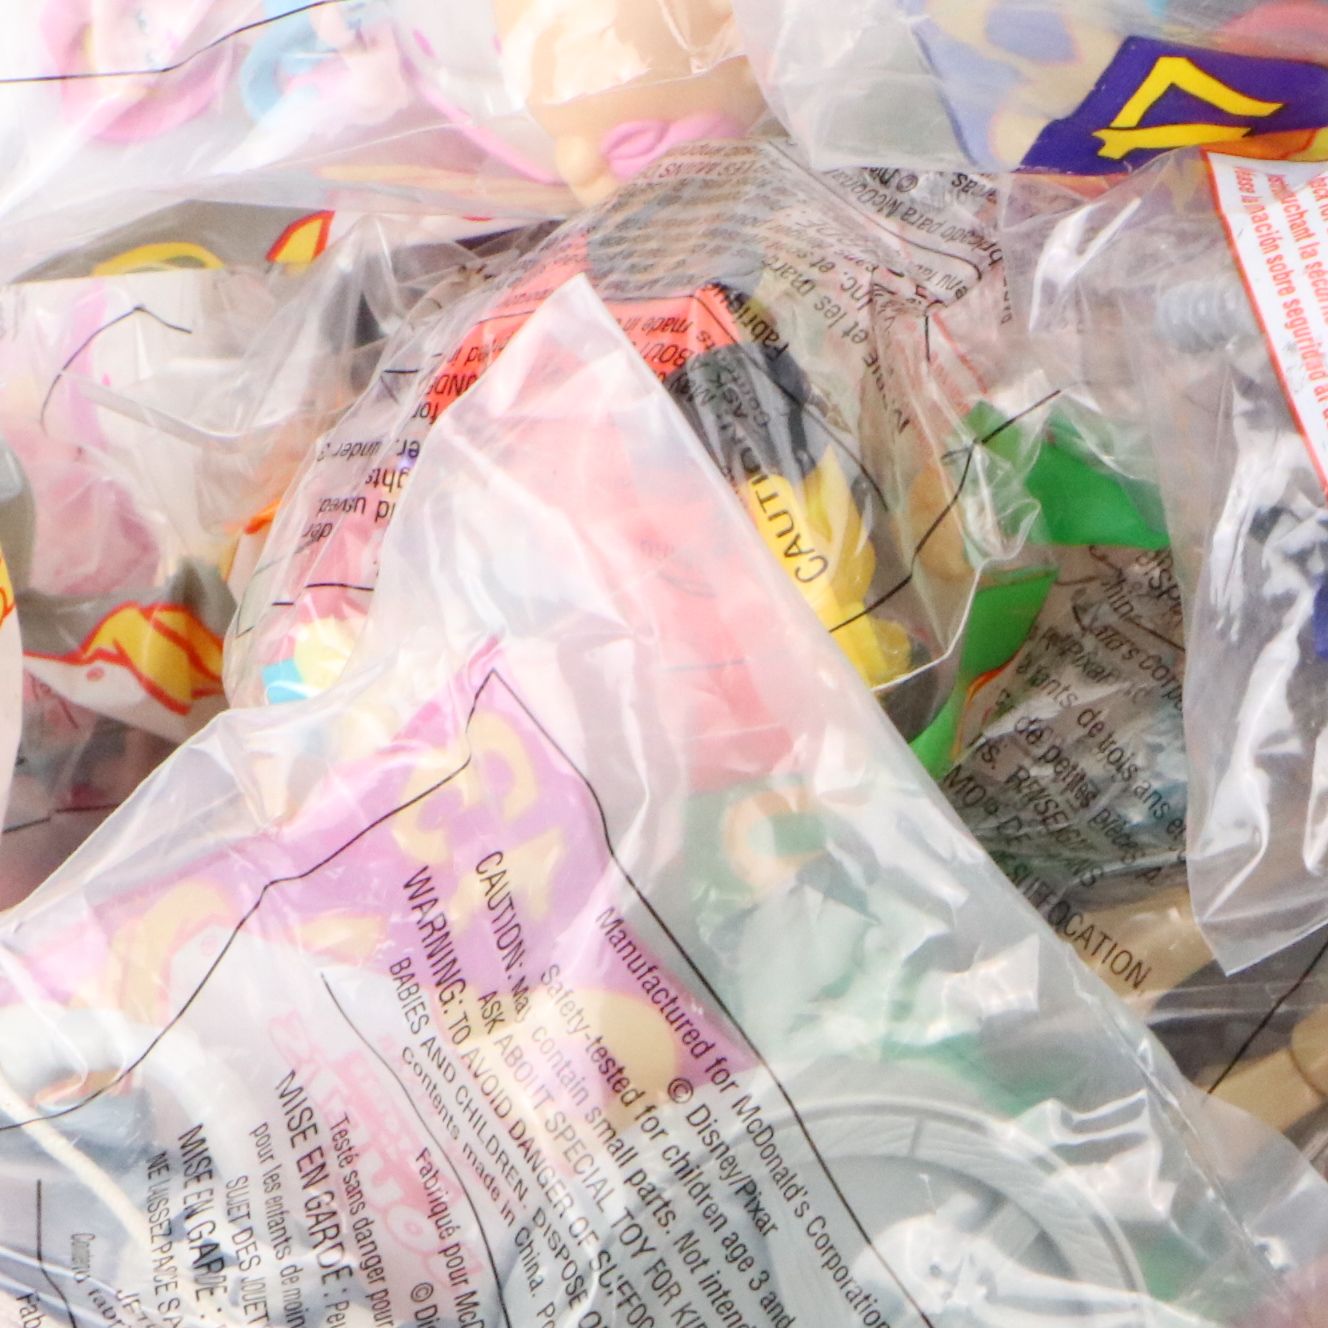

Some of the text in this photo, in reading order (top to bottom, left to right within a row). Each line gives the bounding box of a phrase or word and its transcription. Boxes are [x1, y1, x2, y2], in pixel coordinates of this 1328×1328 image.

[814, 296, 847, 327] les
[1265, 254, 1296, 296] sobre
[403, 865, 467, 1015] WARNING:
[447, 1014, 472, 1046] TO
[509, 1121, 574, 1219] DANGER
[475, 851, 527, 980] CAUTION:
[584, 1106, 639, 1169] small
[624, 1167, 678, 1234] parts.
[674, 1231, 709, 1274] Not
[595, 907, 716, 1060] Manufactured
[705, 1057, 740, 1095] for
[732, 1095, 810, 1218] McDonald's
[177, 1123, 214, 1189] MISE
[274, 1069, 318, 1149] MISE
[329, 1112, 360, 1169] Testé
[389, 956, 430, 1036] BABIES
[419, 1035, 458, 1085] AND
[532, 1208, 589, 1311] DISPOSE
[478, 990, 506, 1035] ASK
[611, 1211, 657, 1259] TOY
[644, 1258, 683, 1307] FOR
[541, 963, 647, 1108] Safety-tested
[634, 1104, 669, 1141] for
[662, 1144, 729, 1233] children
[721, 1232, 755, 1273] age
[249, 1122, 293, 1261] pour enfants
[295, 1146, 330, 1193] EN
[413, 1147, 460, 1240] Fabriqué
[685, 1104, 779, 1238] Disney/Pixar
[303, 1190, 354, 1285] GARDE
